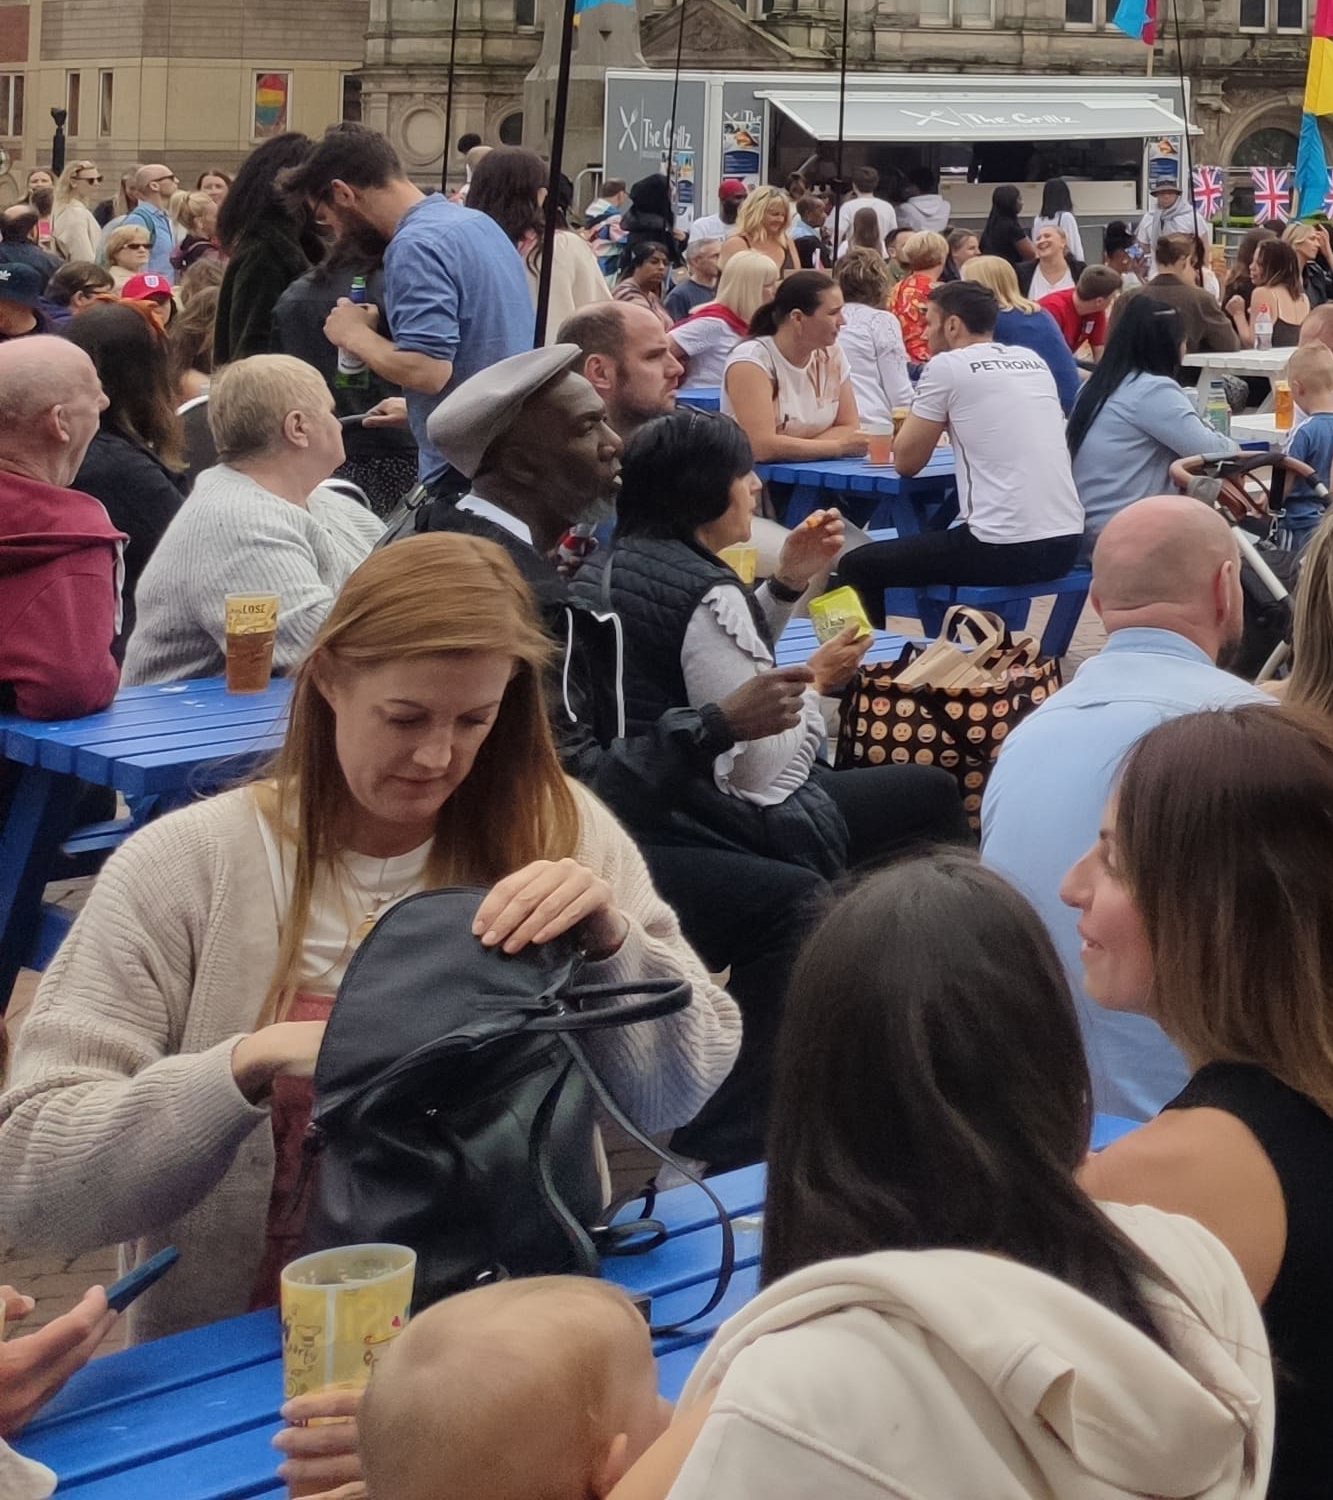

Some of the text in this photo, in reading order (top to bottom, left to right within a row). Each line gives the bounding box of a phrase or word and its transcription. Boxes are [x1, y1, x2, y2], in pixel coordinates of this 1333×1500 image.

[960, 112, 1080, 125] The Grillz
[643, 118, 661, 149] The
[970, 359, 1049, 373] PETRONA
[242, 603, 267, 615] LOSE
